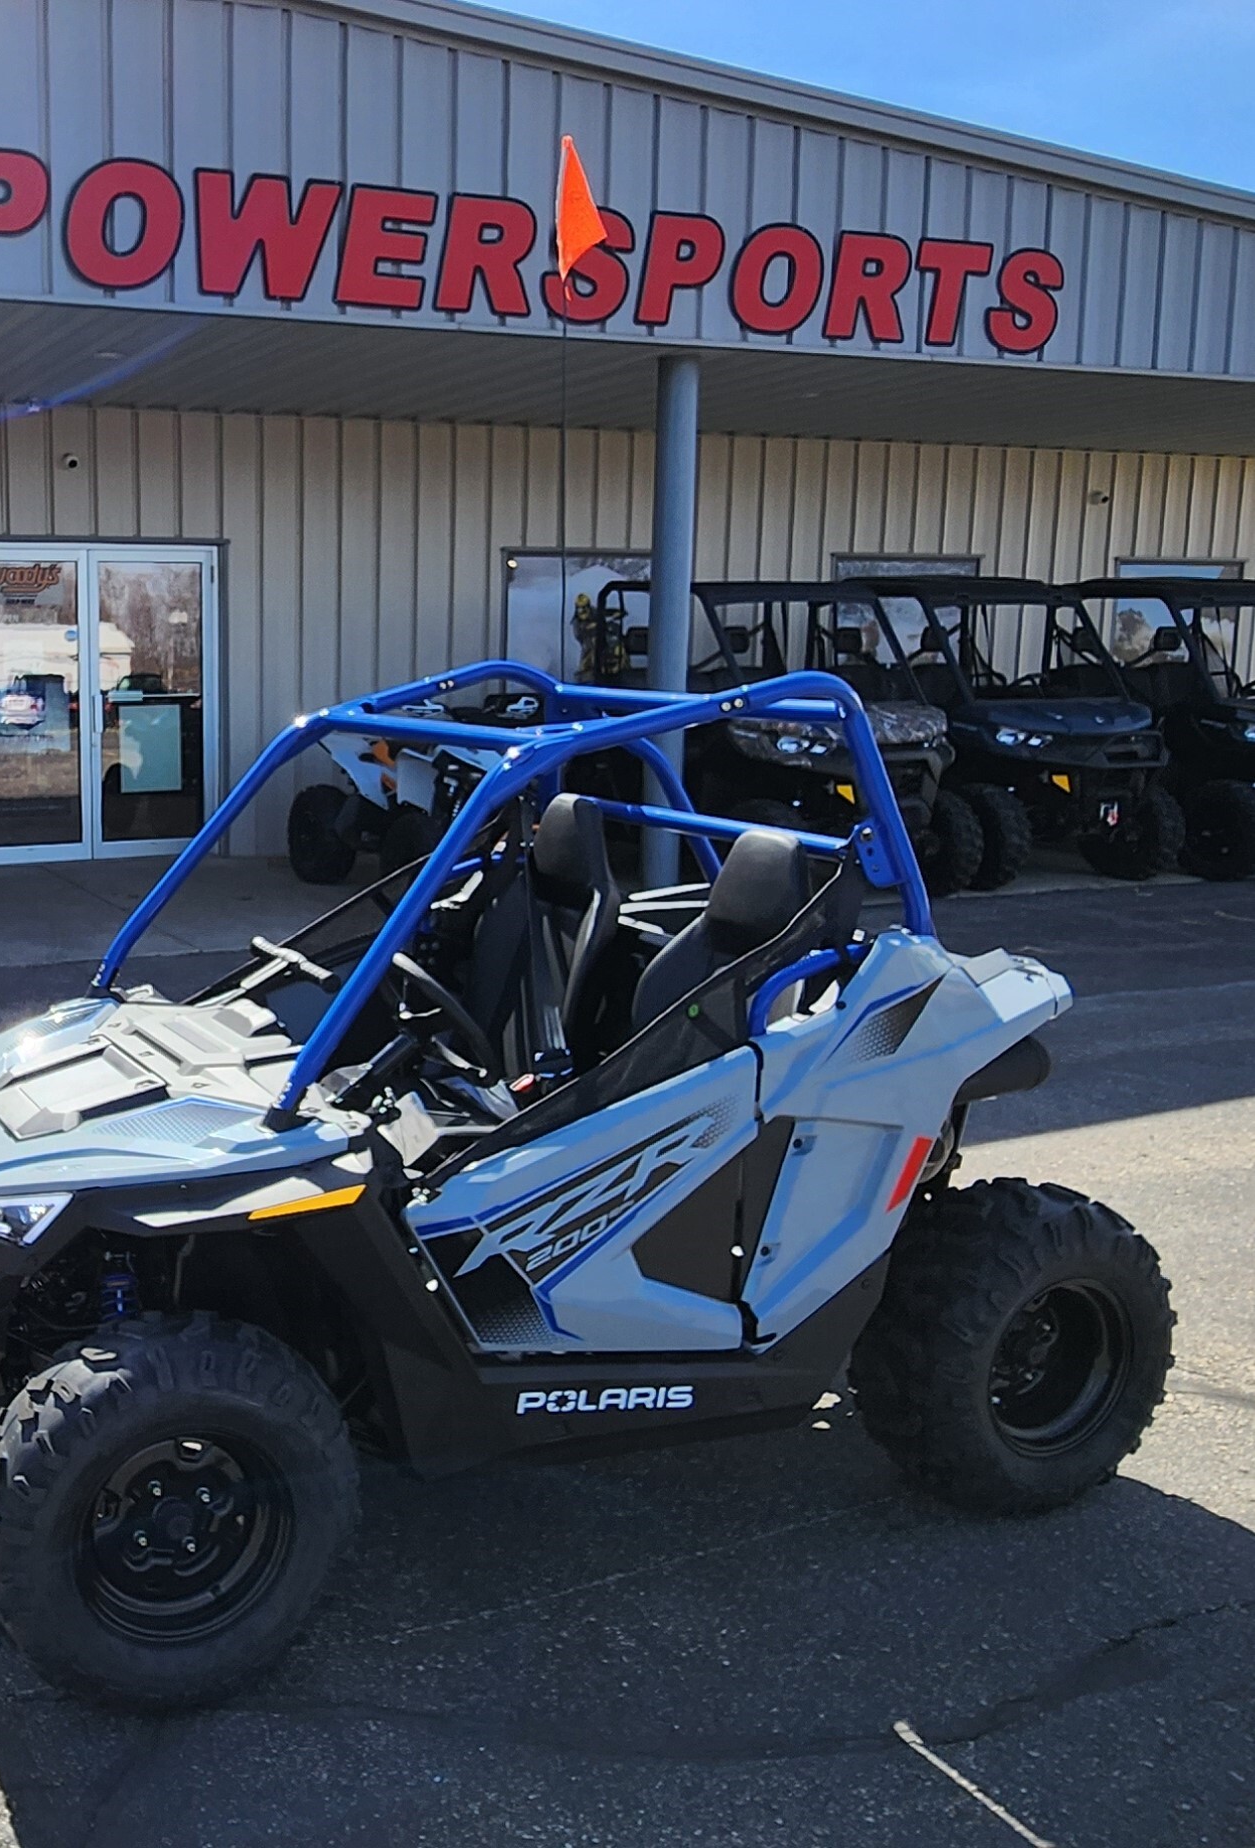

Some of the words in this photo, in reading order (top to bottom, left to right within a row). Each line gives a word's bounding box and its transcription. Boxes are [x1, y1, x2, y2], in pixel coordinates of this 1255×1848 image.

[453, 1115, 715, 1279] RZR
[525, 1214, 609, 1273] 200
[515, 1385, 694, 1415] POLARIS
